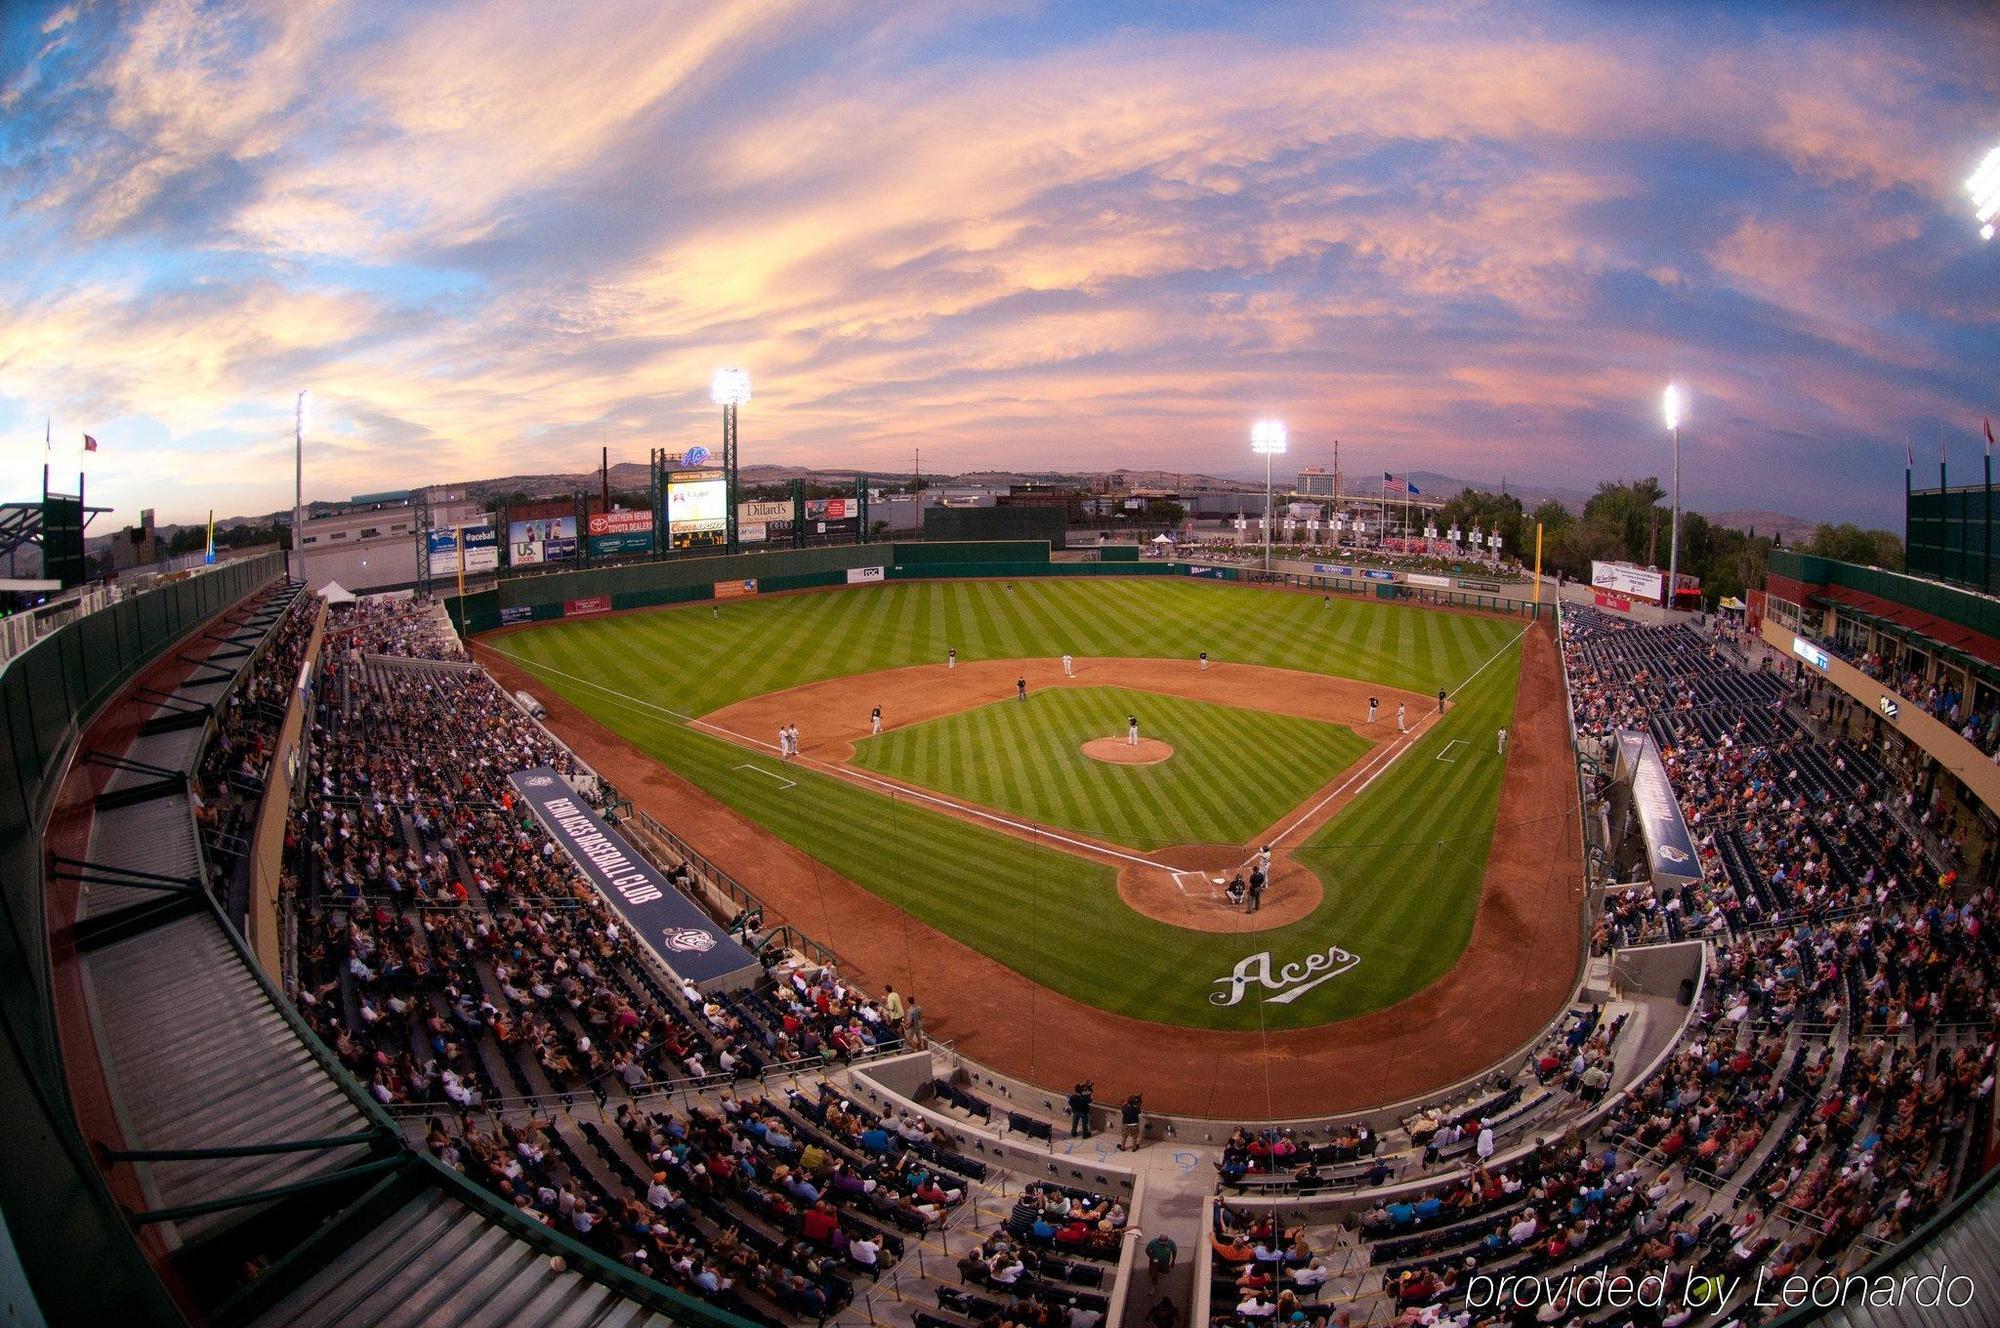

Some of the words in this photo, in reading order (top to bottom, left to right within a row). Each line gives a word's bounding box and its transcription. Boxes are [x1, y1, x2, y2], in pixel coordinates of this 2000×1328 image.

[607, 512, 633, 523] NORTHERN
[634, 510, 653, 521] NEVADA
[747, 503, 787, 516] Dillard's
[465, 530, 496, 542] @aceball
[608, 523, 629, 534] TOYOTA
[629, 521, 653, 531] DEALERS
[544, 798, 580, 818] RENO
[558, 815, 597, 837] ACES
[574, 832, 636, 878] BASEBALL
[612, 874, 663, 904] CLUB
[1209, 945, 1361, 1006] Aces
